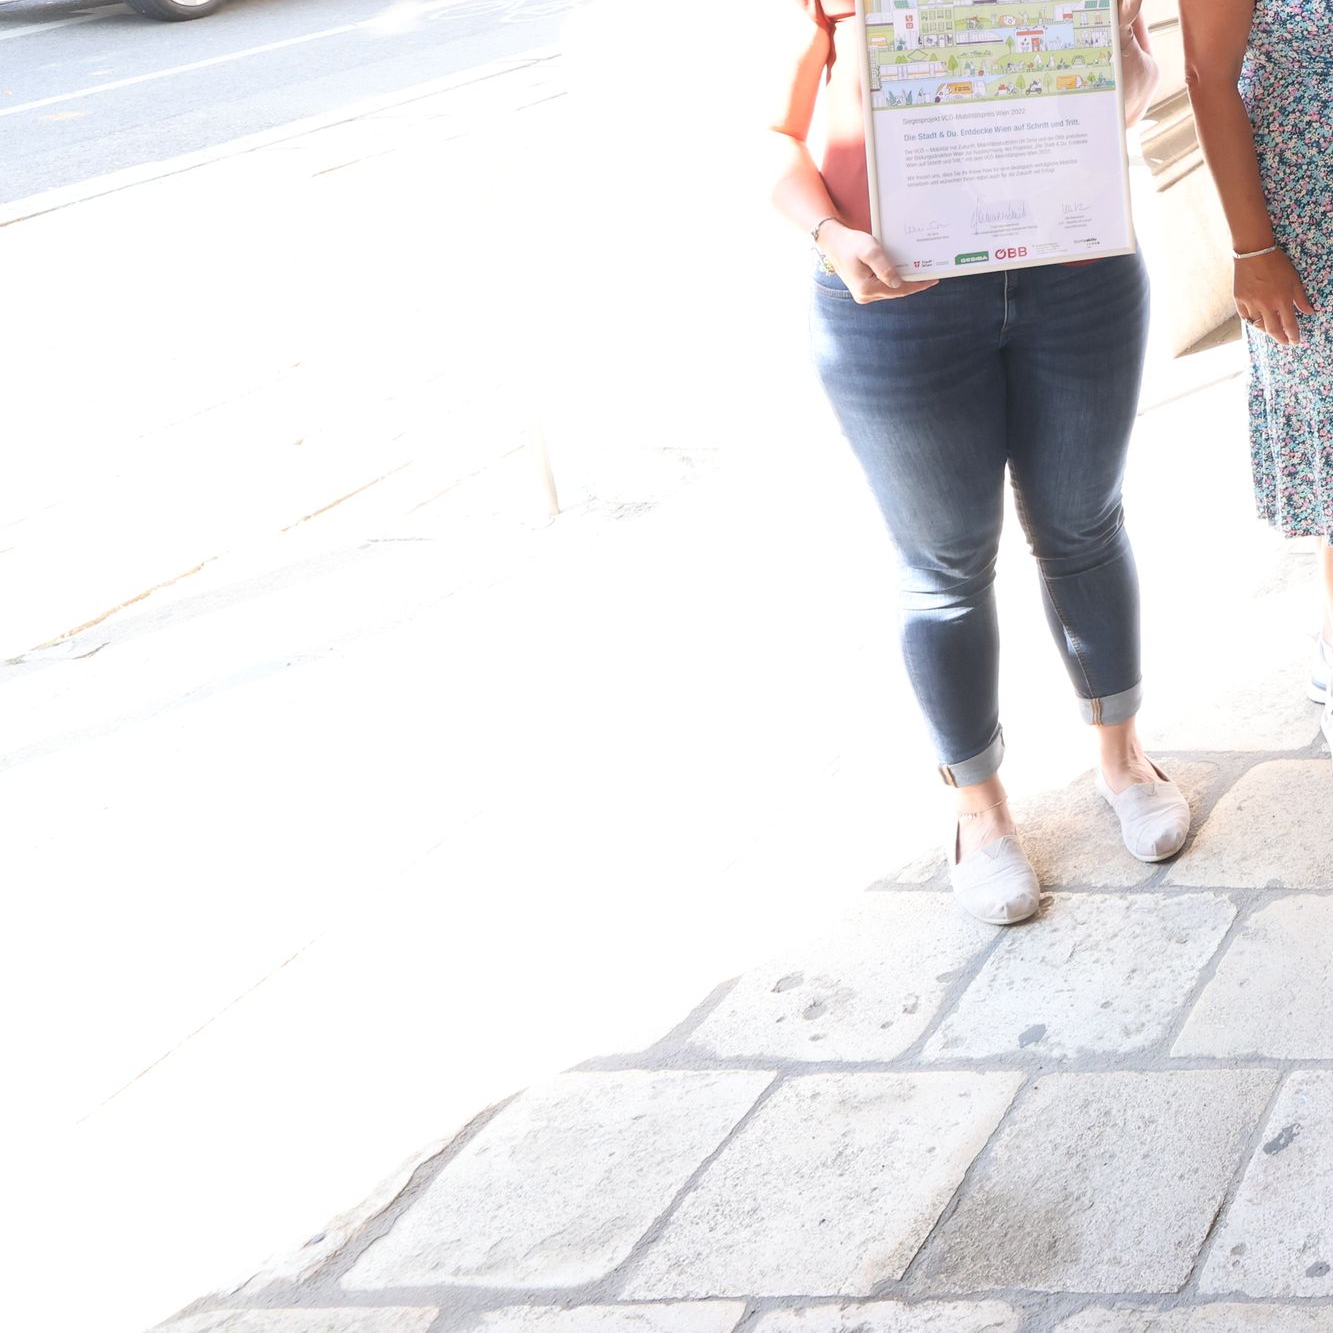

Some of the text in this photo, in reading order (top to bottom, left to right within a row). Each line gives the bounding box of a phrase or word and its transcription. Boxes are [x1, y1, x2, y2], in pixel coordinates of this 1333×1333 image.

[918, 131, 937, 140] Stadt
[960, 127, 993, 137] Entdecke
[994, 125, 1012, 133] Wien
[1013, 123, 1025, 131] auf
[1025, 121, 1049, 130] Schritt
